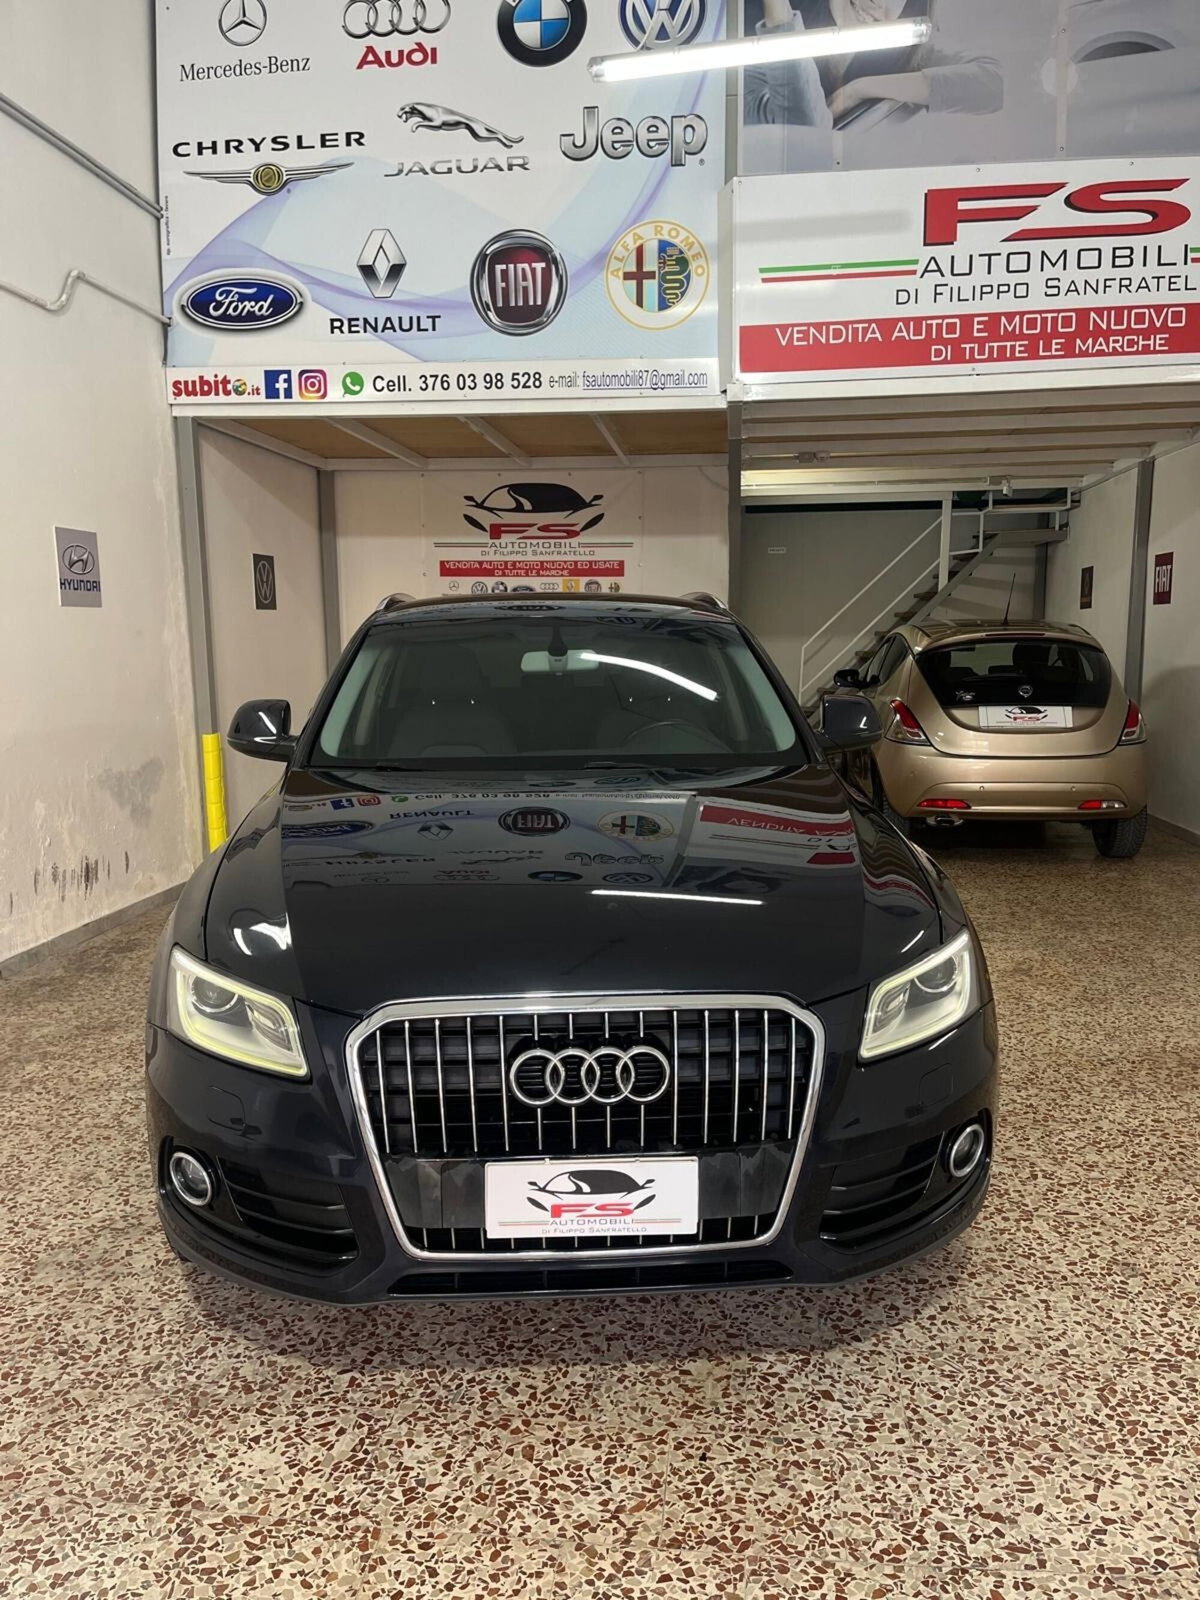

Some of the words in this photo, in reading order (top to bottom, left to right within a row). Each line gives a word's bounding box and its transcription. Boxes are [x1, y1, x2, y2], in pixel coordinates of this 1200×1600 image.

[179, 56, 311, 82] Mercedes-Benz
[356, 42, 438, 70] Audi
[172, 131, 366, 158] CHRYSLER
[560, 106, 708, 167] Jeep
[384, 155, 531, 178] JAGUAR
[923, 178, 1191, 246] FS
[610, 231, 645, 279] ALFA
[654, 224, 706, 278] ROMEO
[919, 244, 1189, 279] AUTOMOBILI
[494, 262, 547, 307] FIAT
[896, 288, 919, 305] DI
[933, 281, 1029, 304] FILIPPO
[1044, 274, 1199, 297] SANFRATEL
[208, 286, 273, 317] Ford
[329, 314, 442, 335] RENAULT
[776, 323, 882, 346] VENDITA
[891, 318, 960, 342] AUTO
[973, 317, 989, 337] E
[1001, 311, 1076, 336] MOTO
[1090, 307, 1186, 331] NUOVO
[930, 345, 952, 362] DI
[961, 341, 1028, 359] TUTTE
[1039, 338, 1065, 356] LE
[1075, 334, 1170, 354] MARCHE
[372, 375, 413, 392] Cell.
[418, 374, 450, 391] 376
[456, 373, 477, 390] 03
[483, 372, 505, 389] 98
[510, 371, 543, 388] 528
[548, 370, 580, 388] e-mail:
[582, 368, 708, 391] fsautomobili87@gmail.com
[489, 523, 581, 539] FS
[489, 541, 581, 549] AUTOMOBILI
[445, 561, 480, 569] VENDITA
[482, 561, 504, 569] AUTO
[516, 561, 540, 569] MOTO
[544, 561, 575, 569] NUOVO
[577, 561, 590, 569] ED
[592, 561, 620, 569] USATE
[1154, 564, 1172, 593] FIAT
[60, 578, 101, 592] HYUNDAI
[550, 1218, 634, 1226] AUTOMOBILI
[551, 1203, 634, 1218] FS
